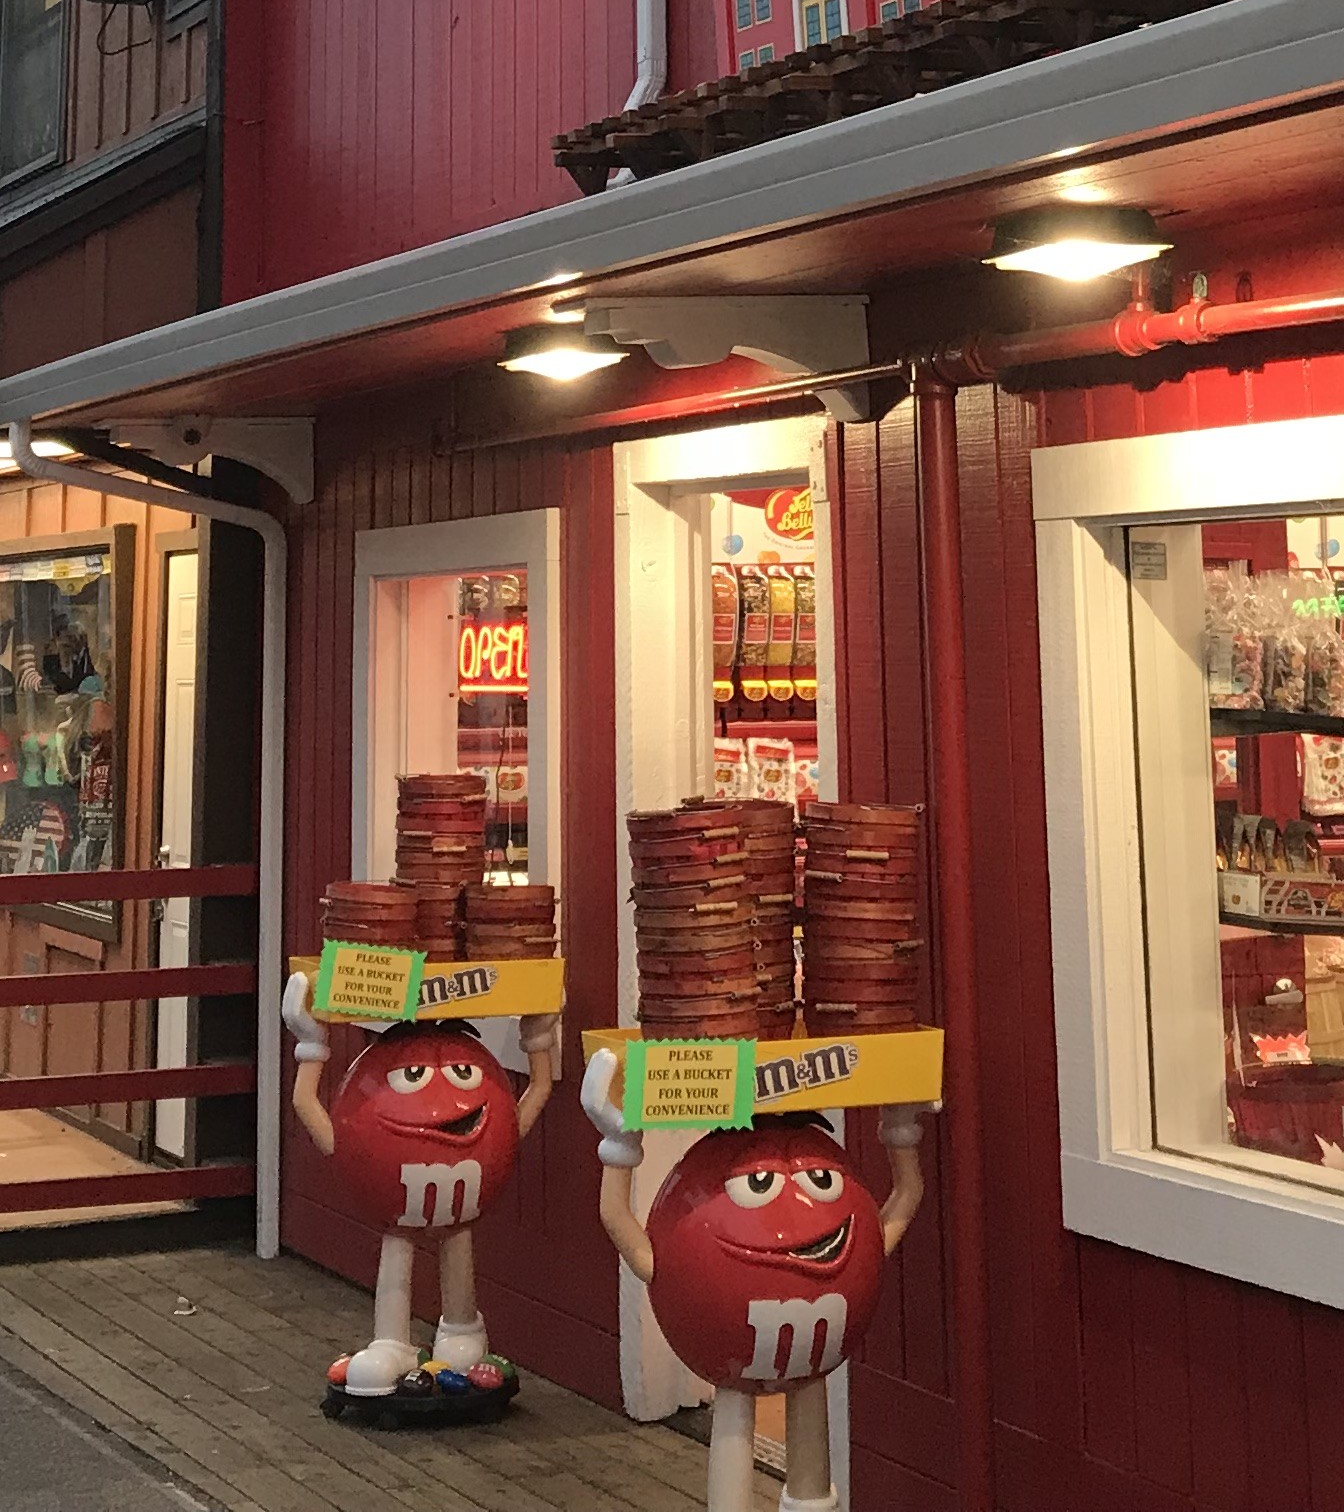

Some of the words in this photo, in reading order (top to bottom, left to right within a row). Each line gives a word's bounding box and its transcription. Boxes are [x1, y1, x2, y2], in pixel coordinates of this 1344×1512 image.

[459, 625, 528, 680] OPEN
[356, 953, 392, 966] PLEASE
[338, 966, 355, 976] USE
[358, 968, 365, 978] A
[366, 969, 406, 982] BUCKET
[345, 982, 363, 992] FOR
[365, 983, 392, 996] YOUR
[333, 993, 400, 1009] CONVENIENCE
[669, 1050, 713, 1062] PLEASE
[648, 1069, 669, 1080] USE
[673, 1069, 681, 1080] A
[684, 1068, 732, 1079] BUCKET
[658, 1088, 682, 1099] FOR
[685, 1088, 718, 1099] YOUR
[645, 1104, 730, 1116] CONVENIENCE
[400, 1160, 481, 1228] m
[742, 1292, 848, 1380] m
